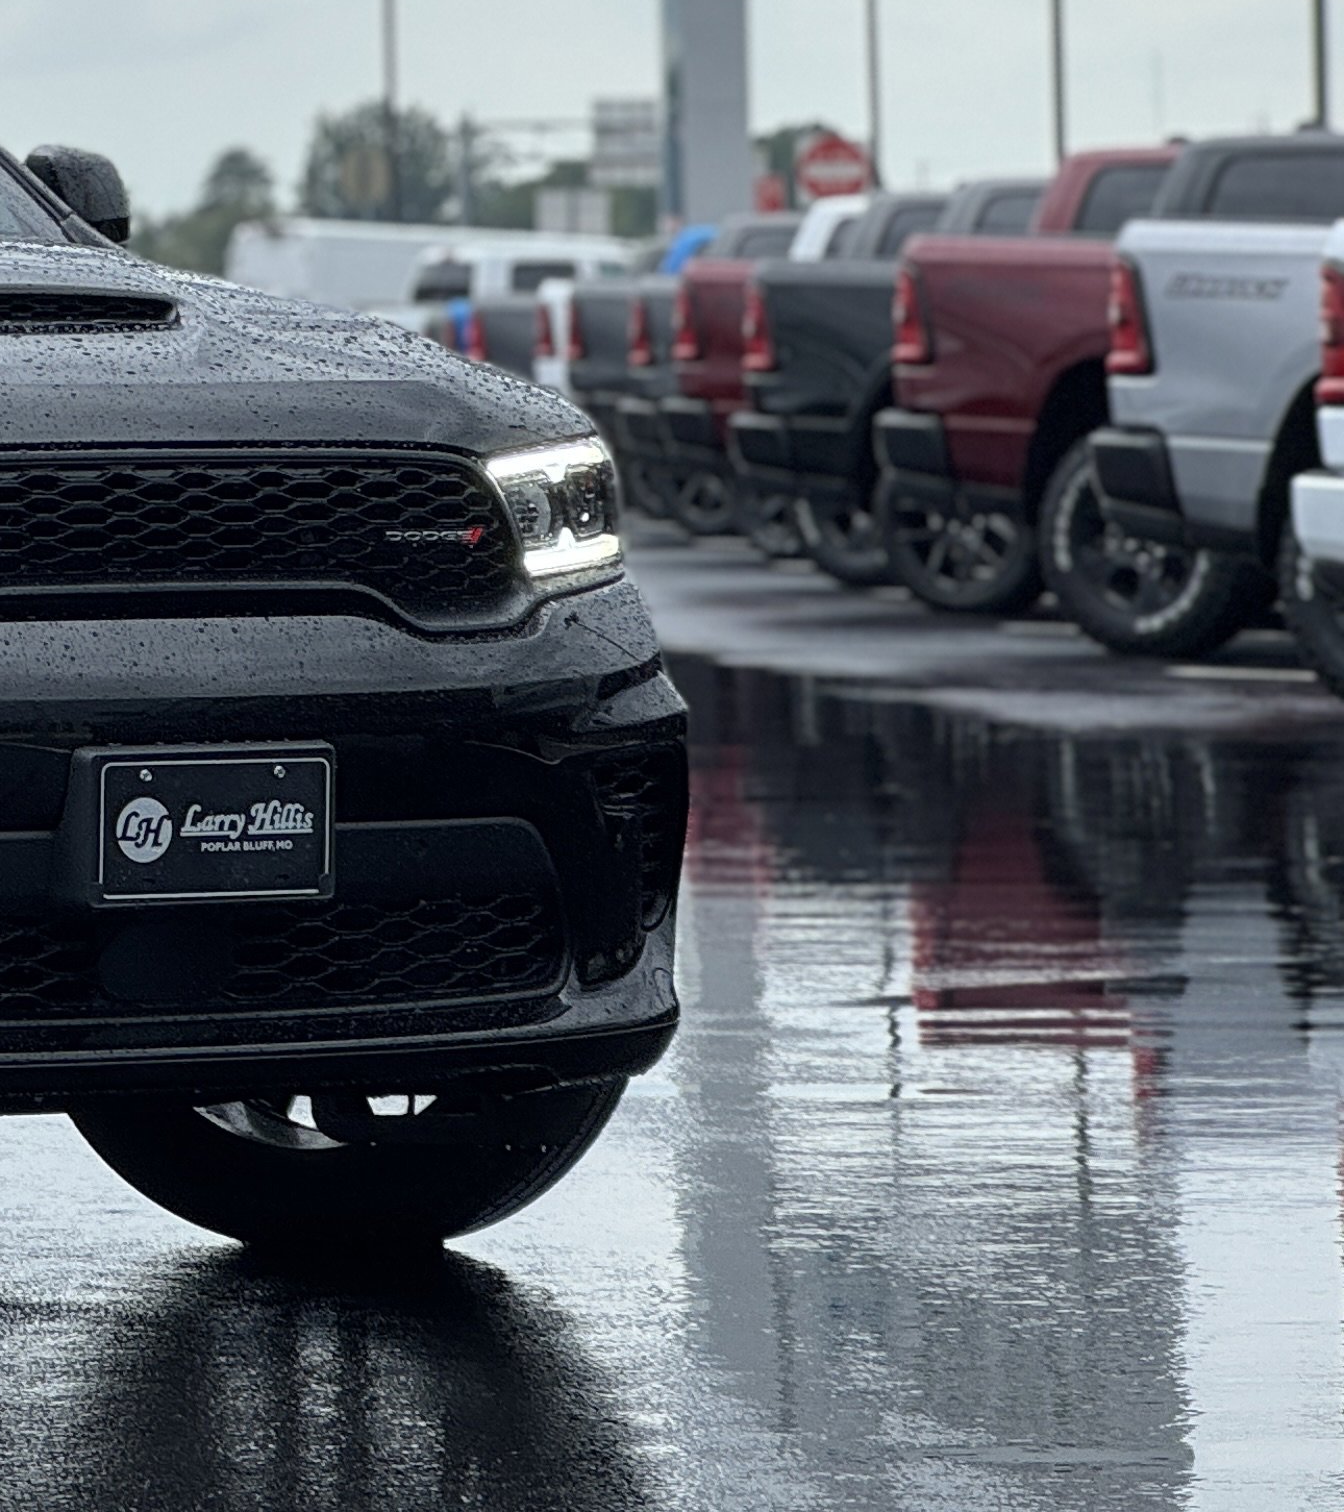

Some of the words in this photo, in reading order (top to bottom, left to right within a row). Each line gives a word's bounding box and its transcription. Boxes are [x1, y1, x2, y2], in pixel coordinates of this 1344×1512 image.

[385, 530, 473, 543] DODGE
[180, 804, 246, 839] Larry
[248, 799, 314, 835] Hillis
[200, 841, 241, 852] POPLAR
[276, 839, 294, 850] MO
